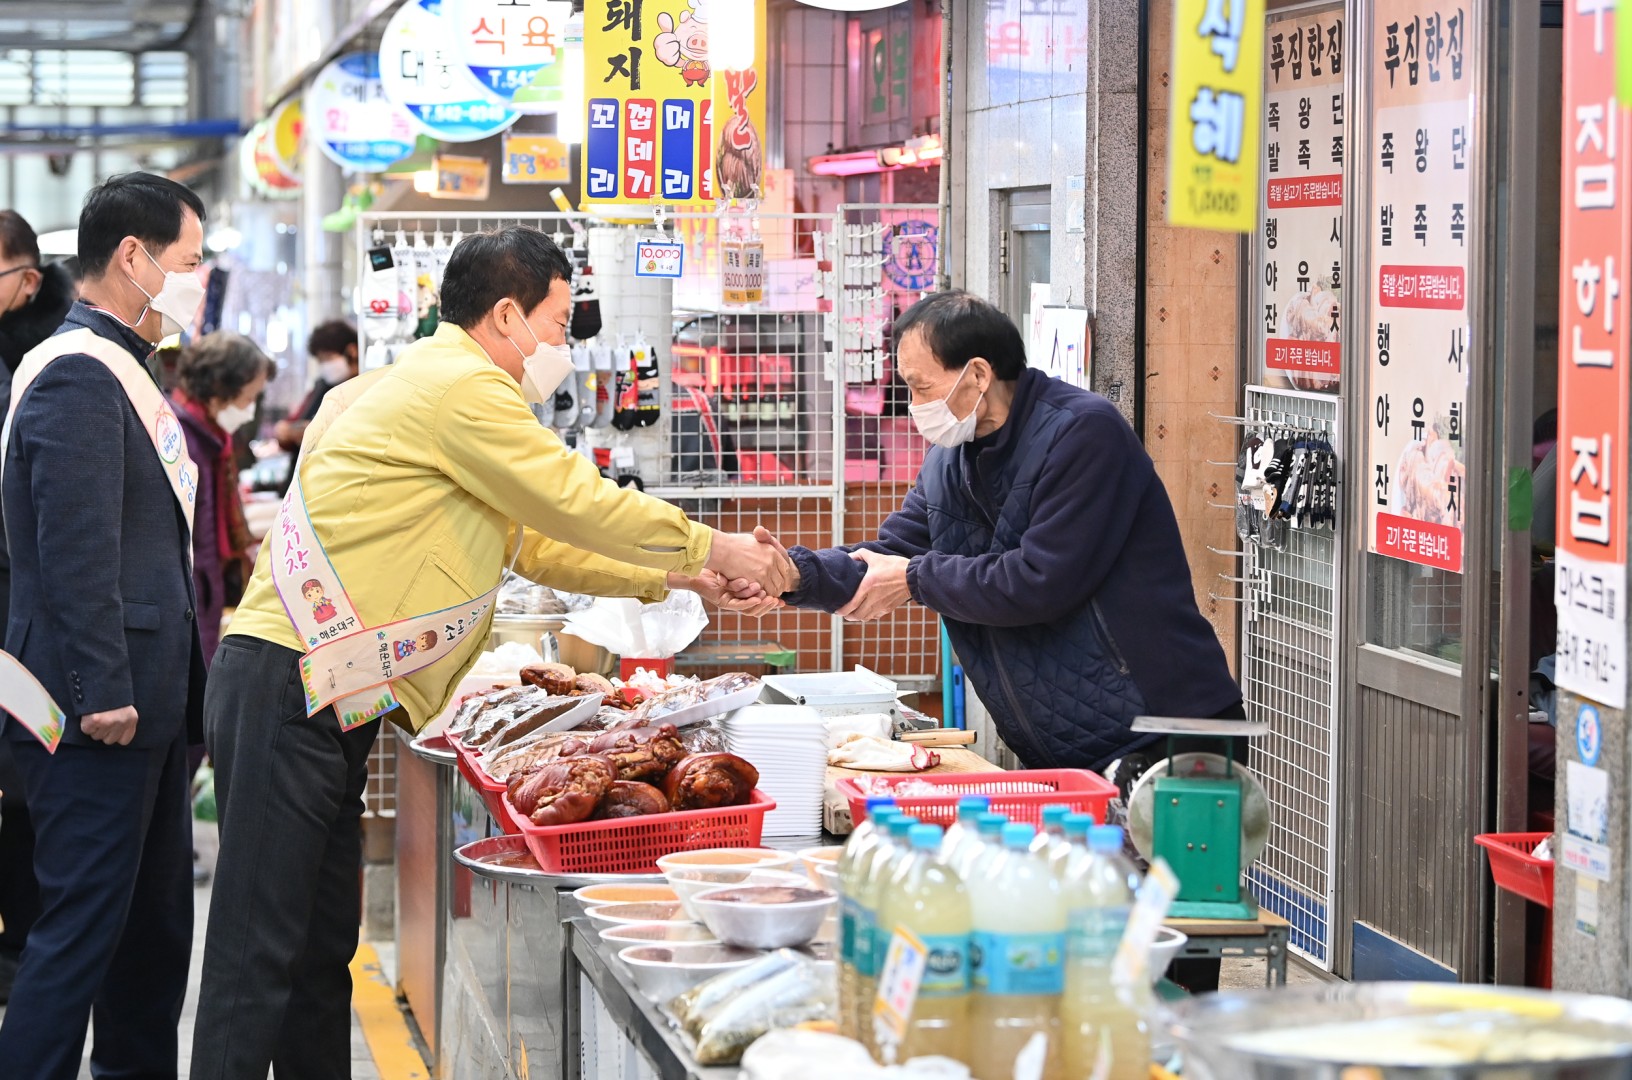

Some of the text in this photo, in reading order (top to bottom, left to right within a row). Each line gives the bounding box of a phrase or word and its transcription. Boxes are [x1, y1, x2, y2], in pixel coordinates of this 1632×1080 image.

[602, 0, 642, 90] 돼지
[1189, 0, 1244, 163] 식혜
[590, 103, 616, 193] 꼬리
[626, 103, 653, 194] 껍데기
[664, 104, 691, 194] 머리
[640, 247, 680, 259] 10,000
[1274, 347, 1333, 367] 고기 주문 받습니다.
[1376, 394, 1463, 447] 야유회
[1385, 526, 1451, 560] 고기 주문 받습니다.
[319, 616, 355, 641] 해운대구
[378, 642, 393, 679] 해운대구
